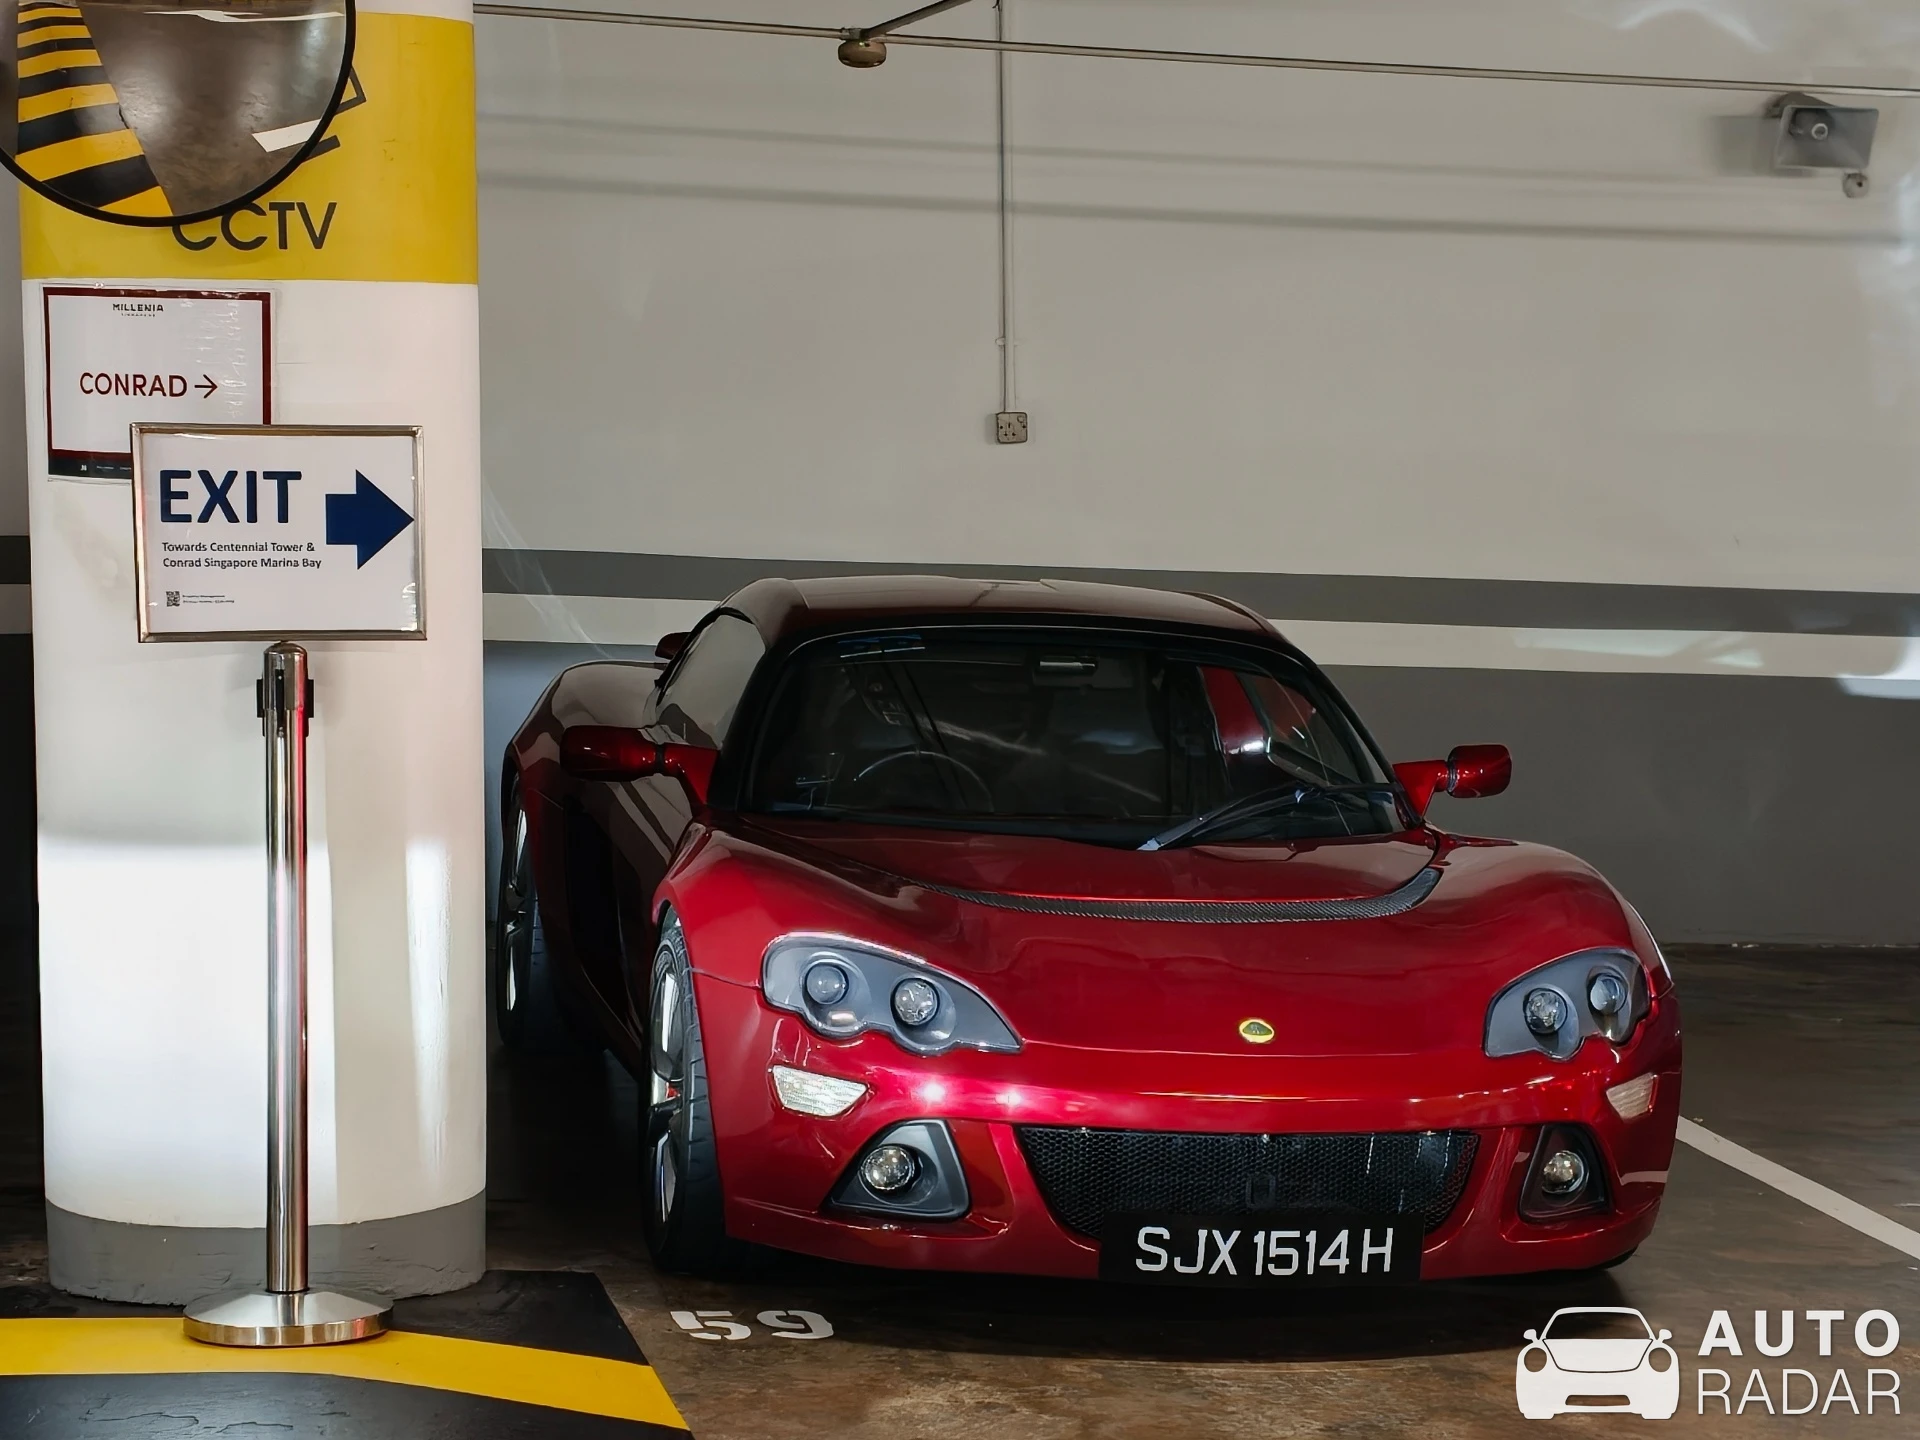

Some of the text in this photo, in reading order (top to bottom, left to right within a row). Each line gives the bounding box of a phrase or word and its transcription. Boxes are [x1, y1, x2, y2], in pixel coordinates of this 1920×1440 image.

[112, 303, 164, 312] MILLENIA
[79, 371, 188, 398] CONRAD
[159, 469, 303, 524] EXIT
[161, 541, 316, 552] Towards Centennial Tower &
[162, 557, 322, 570] Conrad Singapore Marina Bay
[1135, 1226, 1394, 1276] SJX 1514 H
[669, 1310, 835, 1341] 59
